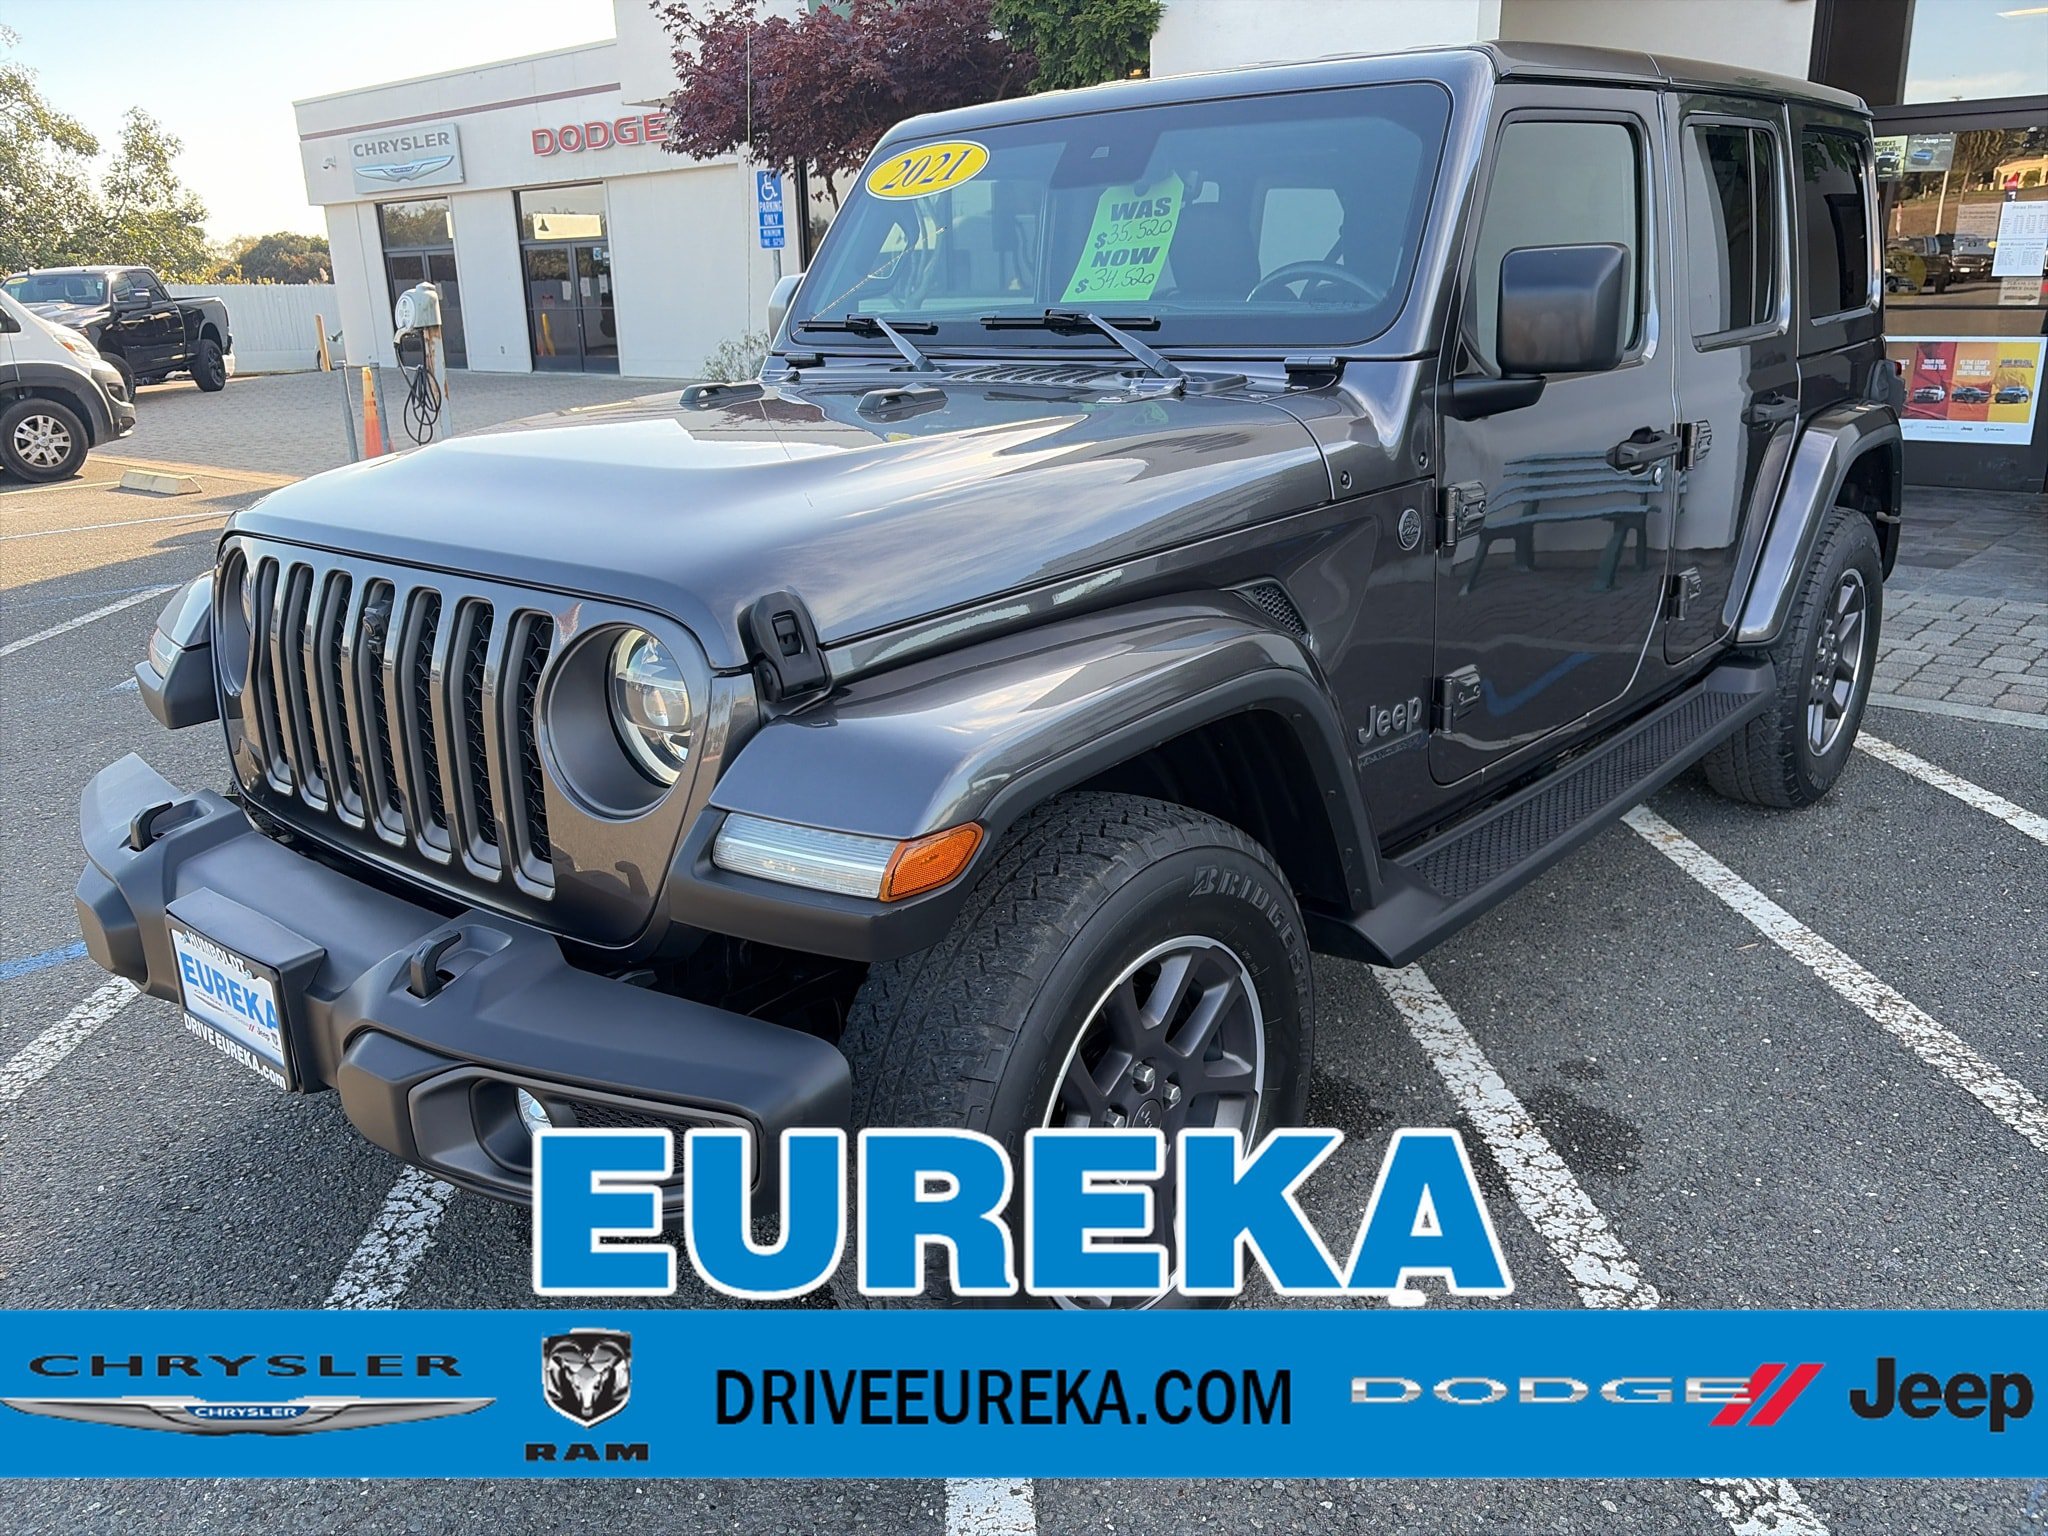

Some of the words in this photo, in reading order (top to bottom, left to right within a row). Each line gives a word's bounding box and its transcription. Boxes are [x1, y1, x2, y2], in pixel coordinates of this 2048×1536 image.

[353, 132, 450, 157] CHRYSLER
[532, 112, 669, 156] DODGE
[880, 148, 973, 190] 2021
[763, 213, 779, 226] ONLY
[1111, 197, 1172, 222] WAS
[1091, 246, 1161, 268] NOW
[1358, 697, 1423, 744] Jeep
[180, 951, 279, 1031] EUREKA
